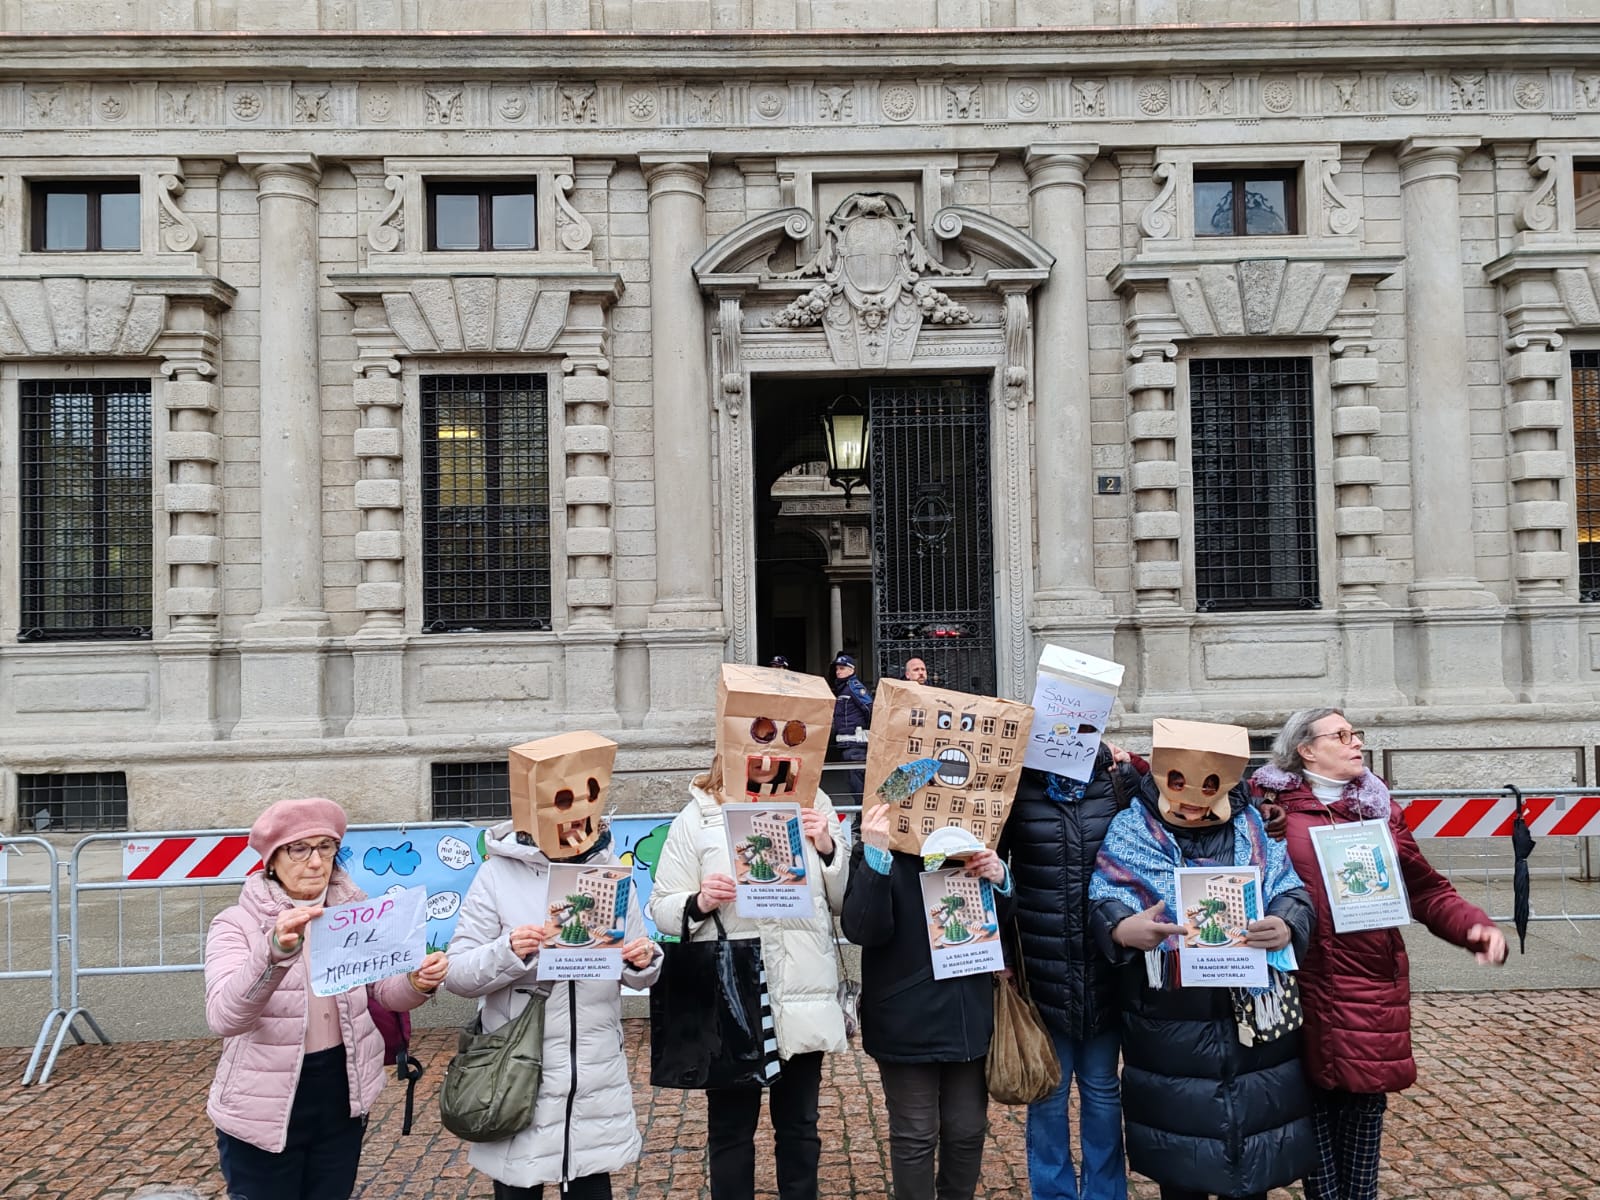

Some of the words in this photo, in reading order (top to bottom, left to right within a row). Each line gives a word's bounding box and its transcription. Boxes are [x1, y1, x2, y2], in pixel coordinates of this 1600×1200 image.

[1106, 477, 1114, 491] 2
[1042, 687, 1081, 707] SALVA
[1033, 733, 1084, 748] SALVA
[1043, 746, 1096, 762] CHI?
[328, 899, 394, 931] STOP
[343, 928, 380, 948] AL
[325, 950, 412, 984] MALAFFARE
